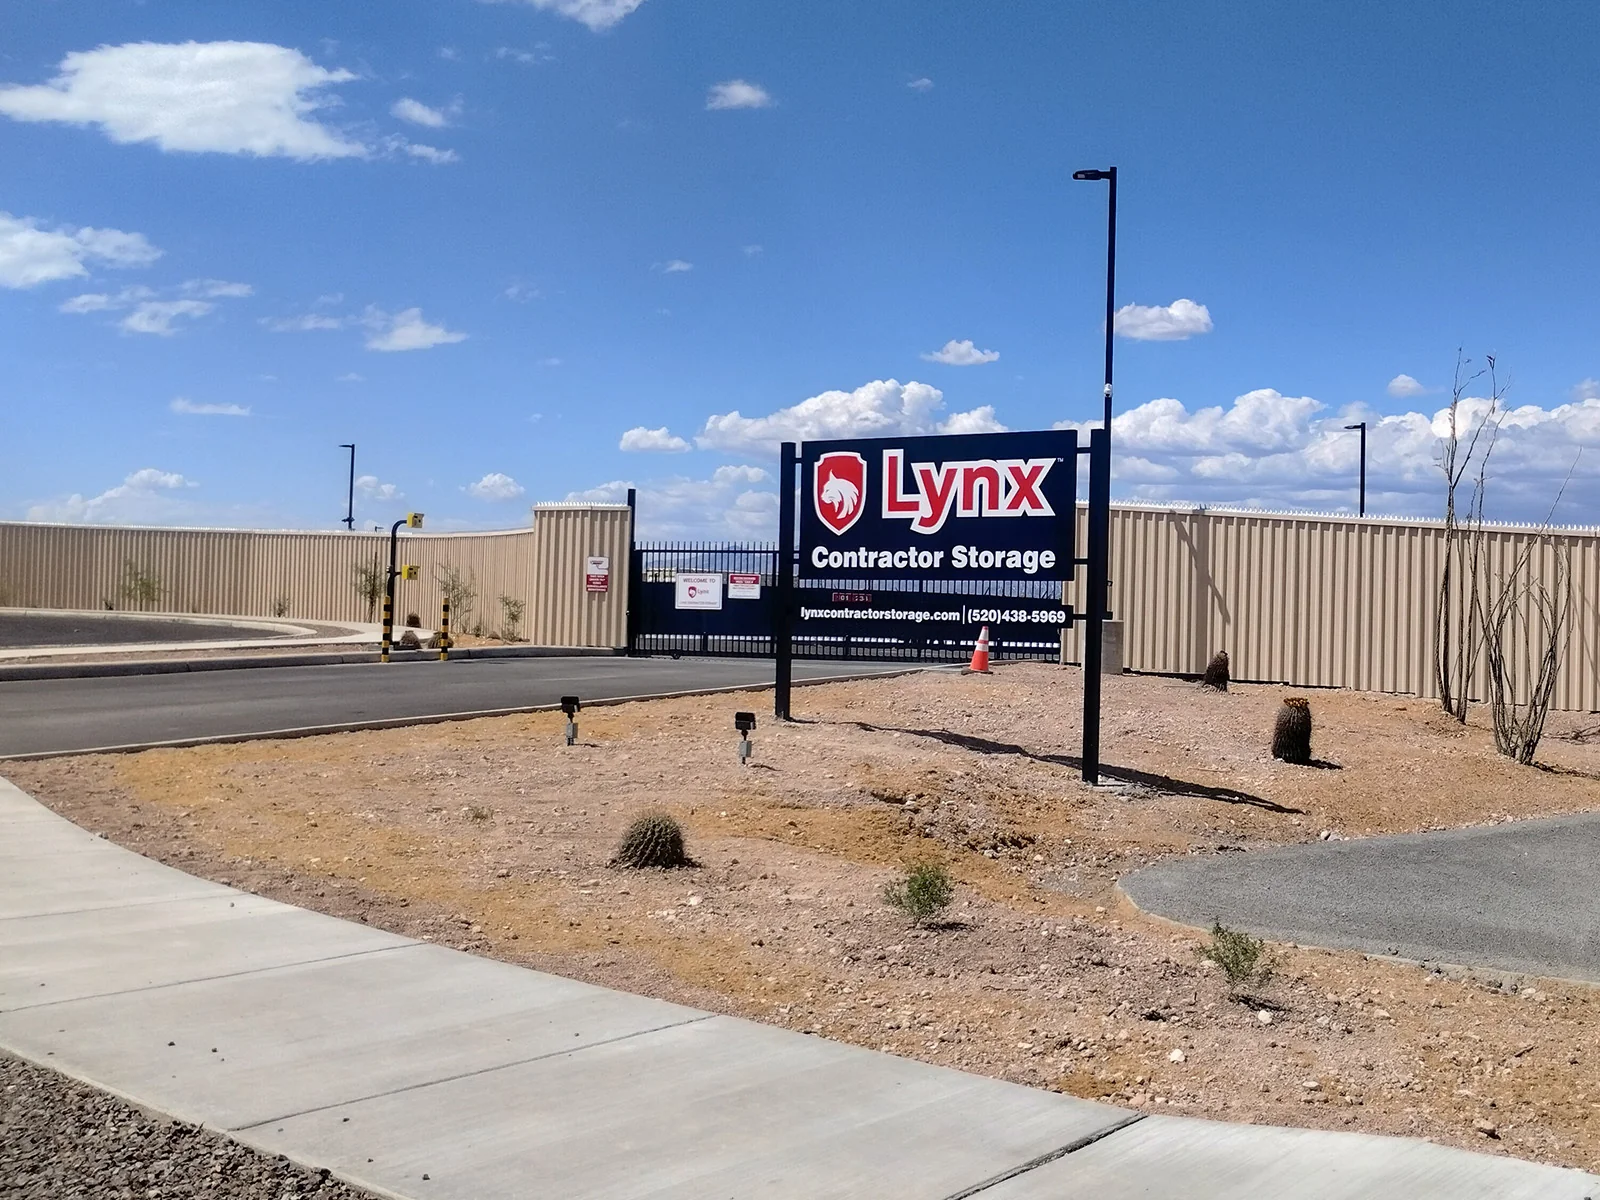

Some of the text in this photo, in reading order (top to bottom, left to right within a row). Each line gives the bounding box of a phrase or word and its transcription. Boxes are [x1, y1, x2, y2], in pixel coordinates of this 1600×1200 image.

[882, 449, 1056, 535] Lynx
[811, 545, 1056, 574] Contractor Storage
[800, 606, 1066, 624] lynxcontractorstorage.com (520)438-5969
